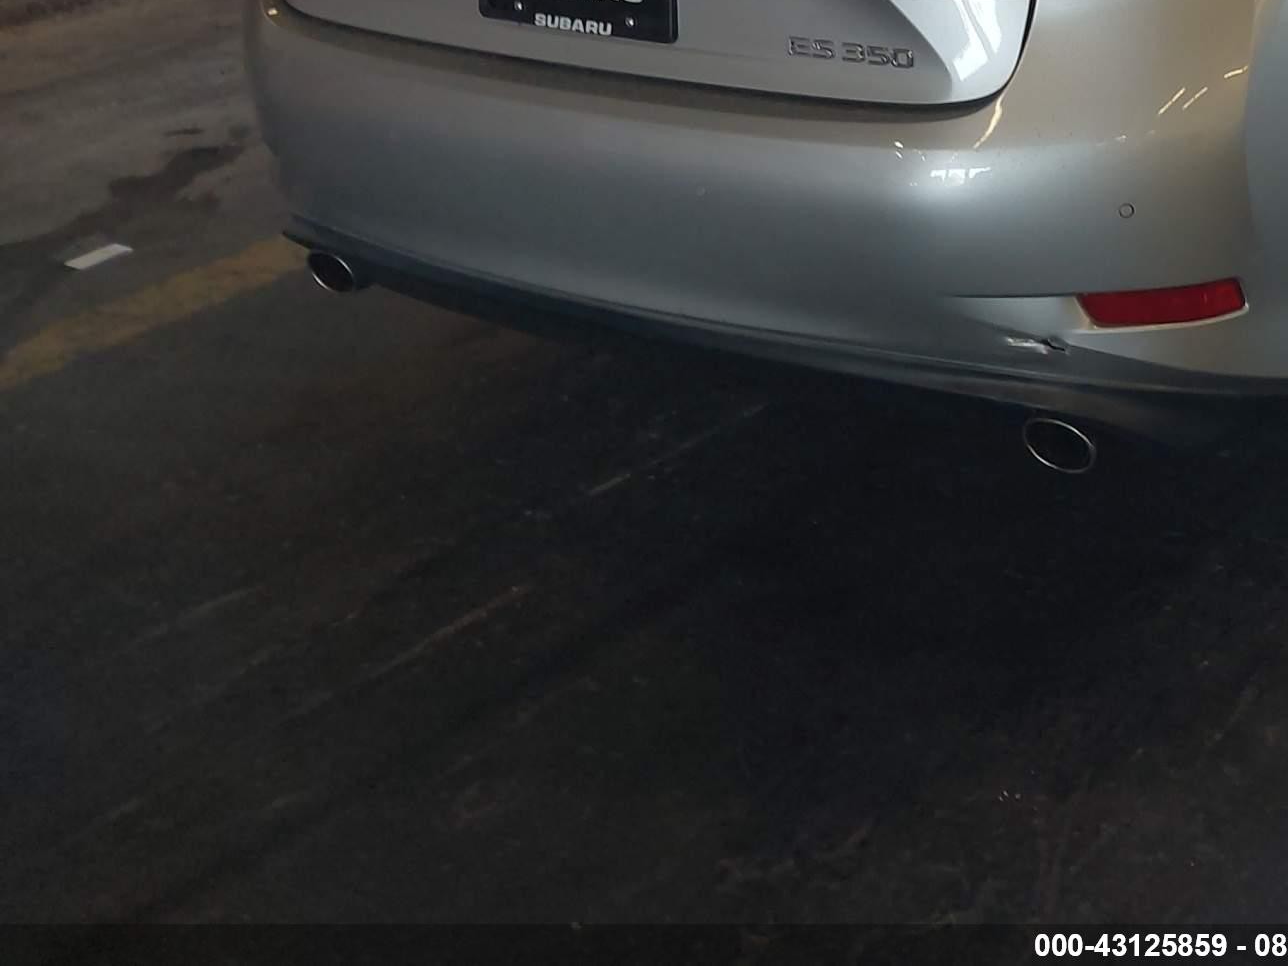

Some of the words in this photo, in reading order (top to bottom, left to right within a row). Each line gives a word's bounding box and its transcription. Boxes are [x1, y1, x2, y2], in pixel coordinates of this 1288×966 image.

[534, 13, 612, 35] SUBARU
[788, 35, 835, 60] ES
[841, 42, 915, 69] 350
